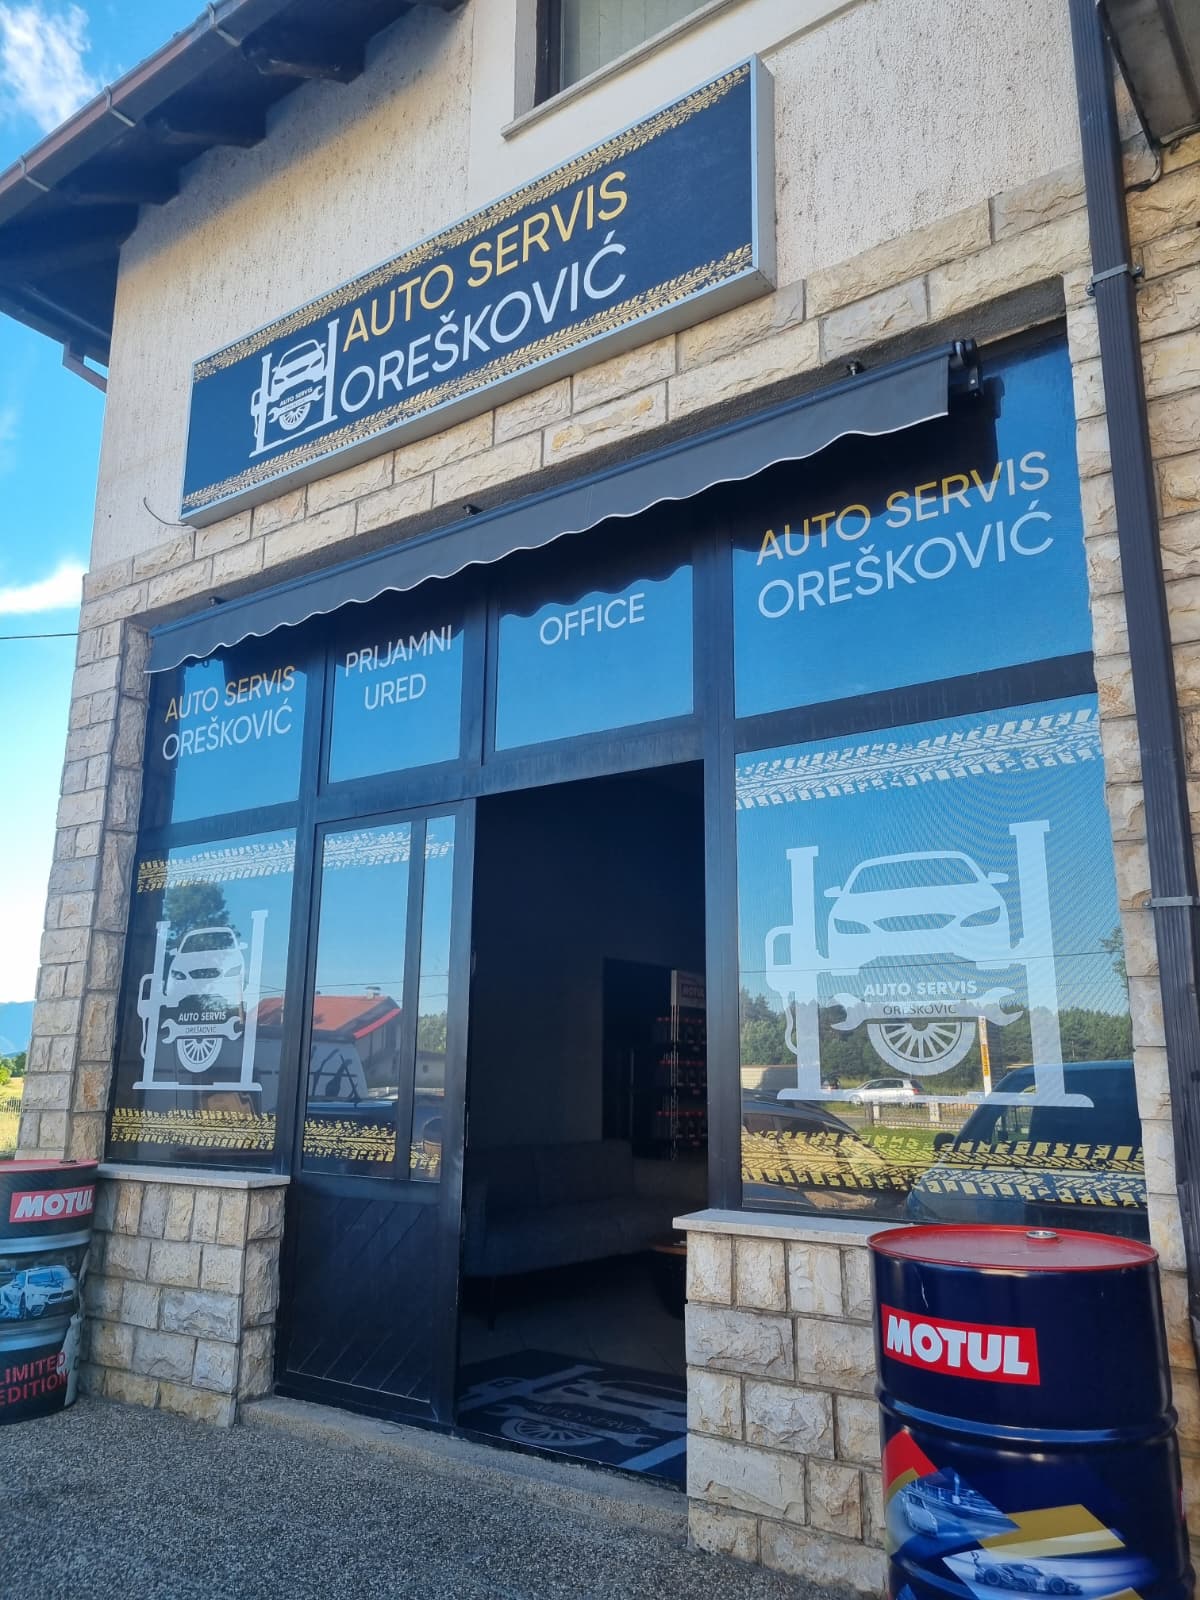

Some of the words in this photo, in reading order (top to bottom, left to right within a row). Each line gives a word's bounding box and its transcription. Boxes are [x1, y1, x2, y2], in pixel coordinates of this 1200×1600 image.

[343, 265, 453, 352] AUTO
[467, 170, 628, 288] SERVIS
[341, 230, 627, 413] OREŠKOVIĆ
[756, 504, 871, 566] AUTO
[885, 451, 1050, 528] SERVIS
[758, 500, 1054, 618] OREŠKOVIĆ
[539, 593, 645, 646] OFFICE
[345, 625, 453, 677] PRIJAMNI
[164, 687, 220, 723] AUTO
[224, 665, 297, 707] SERVIS
[364, 673, 427, 710] URED
[162, 698, 293, 761] OREŠKOVIĆ
[863, 983, 912, 997] AUTO
[916, 980, 978, 995] SERVIS
[178, 1012, 199, 1022] AUTO
[201, 1011, 226, 1021] SERVIS
[14, 1188, 93, 1219] MOTUL
[0, 1352, 66, 1386] IMITED
[886, 1314, 1029, 1375] MOTUL
